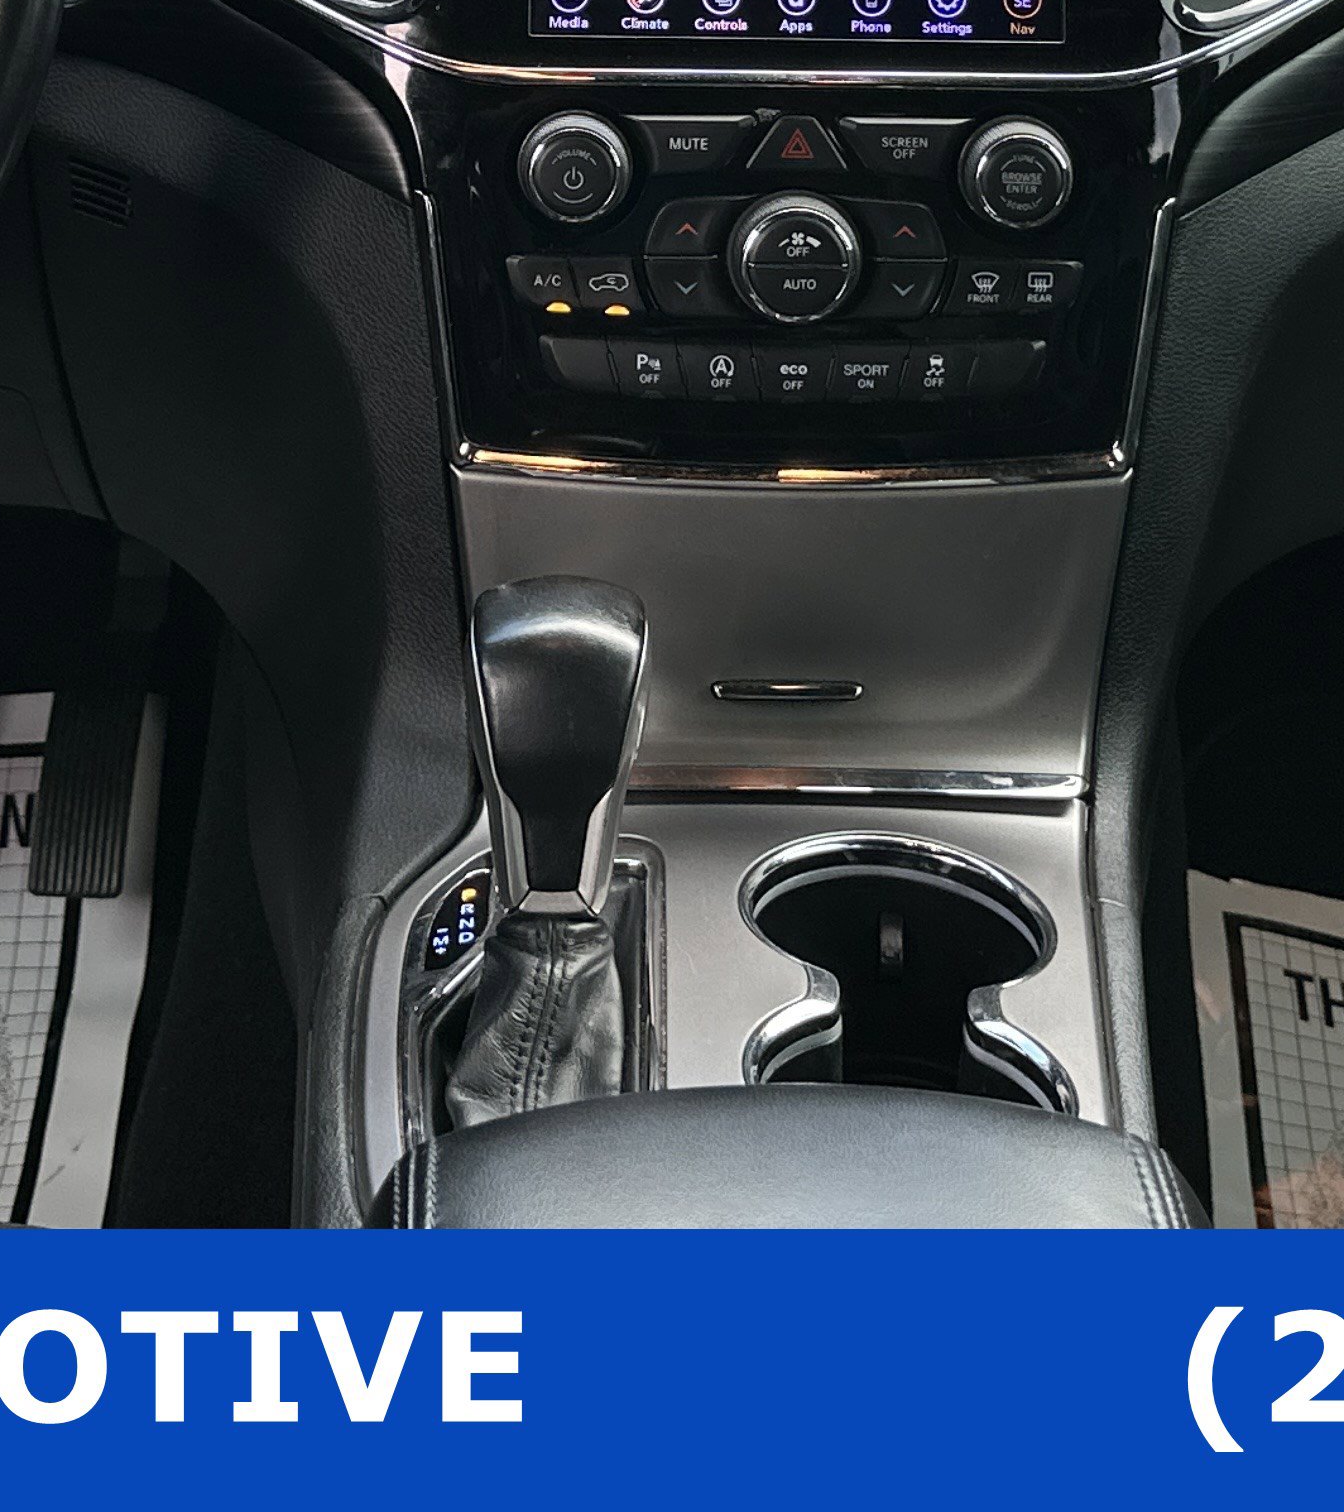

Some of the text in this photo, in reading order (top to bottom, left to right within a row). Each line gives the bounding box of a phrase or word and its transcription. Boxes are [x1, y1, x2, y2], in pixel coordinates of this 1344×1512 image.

[549, 16, 589, 30] Media
[620, 17, 670, 31] Climate
[693, 18, 748, 32] Controls
[778, 19, 813, 34] Apps
[850, 19, 892, 34] Phone
[921, 21, 973, 36] Settings
[1009, 22, 1036, 35] Nav
[668, 137, 709, 151] MUTE
[881, 136, 928, 149] SCREEN
[556, 149, 592, 161] VOLUME
[892, 148, 916, 159] OFF
[1001, 171, 1043, 183] BROWSE
[1006, 184, 1038, 195] ENTER
[786, 245, 810, 257] OFF
[533, 274, 562, 288] A/C
[782, 278, 817, 291] AUTO
[967, 293, 1000, 304] FRONT
[1026, 293, 1053, 304] REAR
[779, 364, 808, 376] eco
[843, 363, 889, 377] SPORT
[639, 373, 661, 384] OFF
[710, 377, 733, 389] OFF
[857, 377, 875, 389] ON
[923, 376, 946, 388] OFF
[782, 379, 805, 391] OFF
[460, 903, 475, 915] R
[459, 917, 475, 930] N
[458, 931, 475, 944] D
